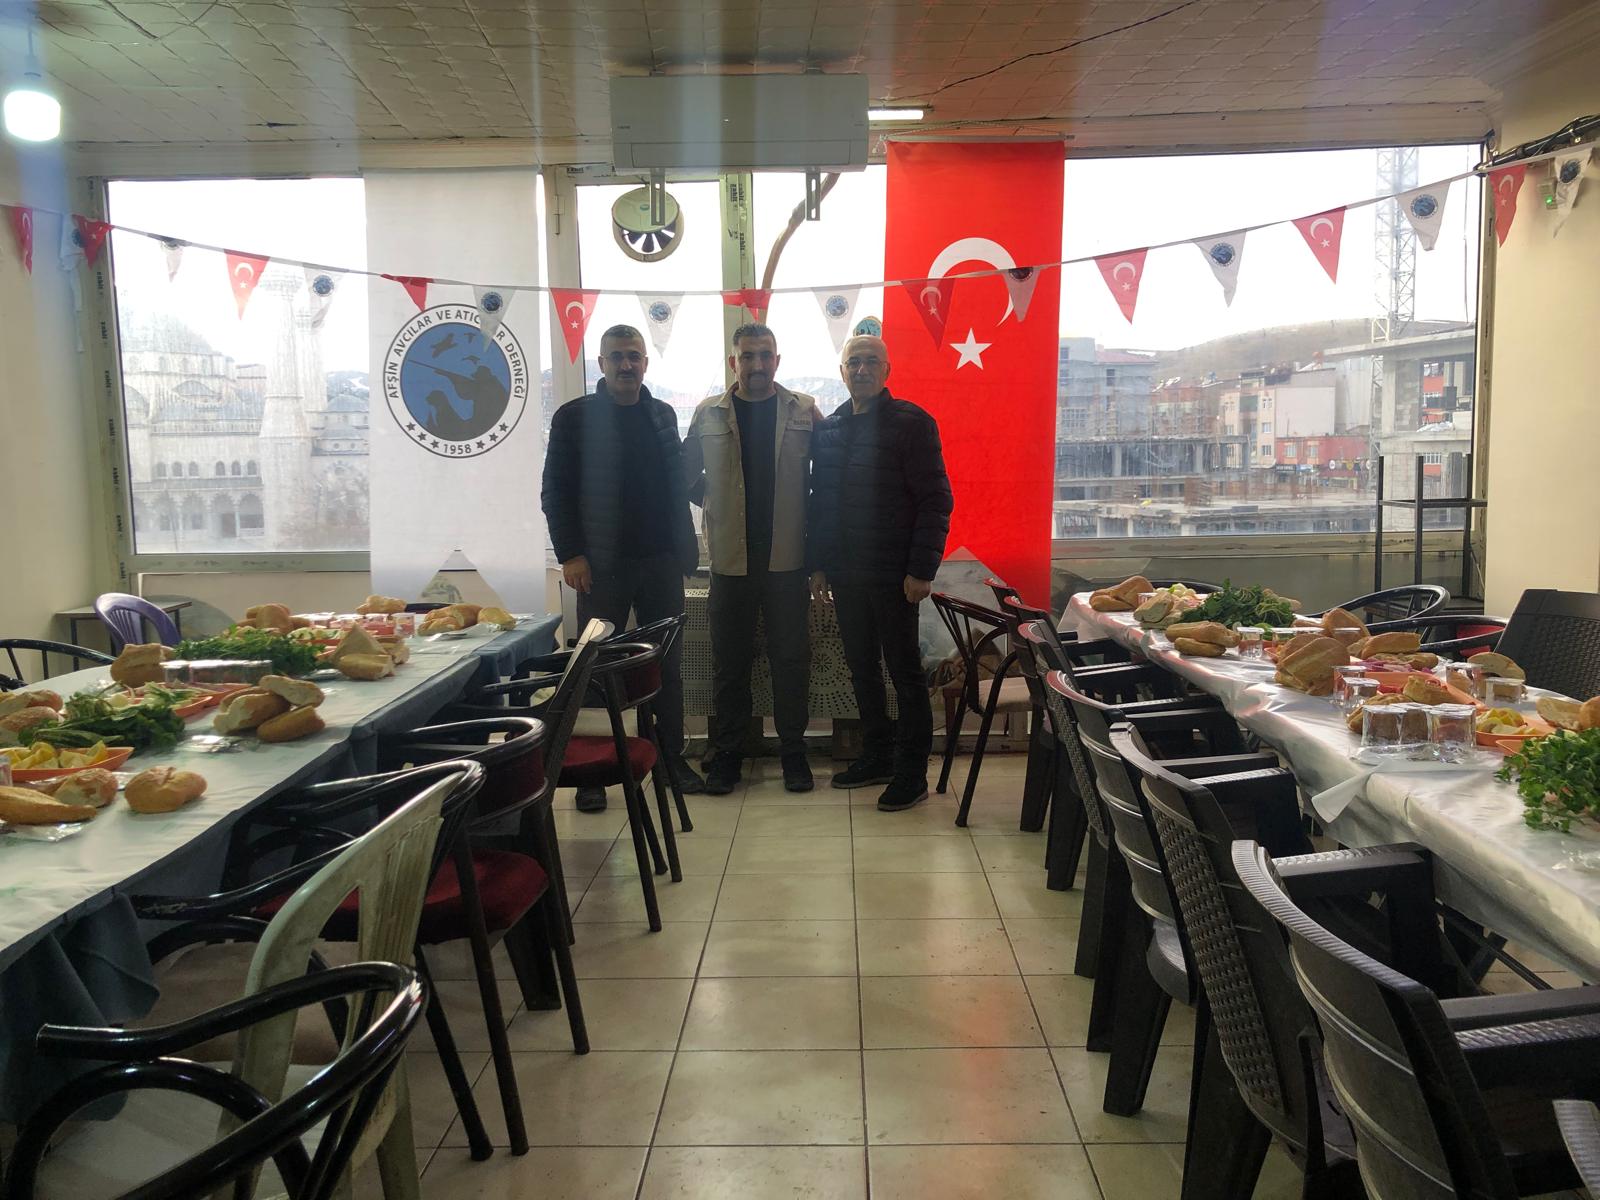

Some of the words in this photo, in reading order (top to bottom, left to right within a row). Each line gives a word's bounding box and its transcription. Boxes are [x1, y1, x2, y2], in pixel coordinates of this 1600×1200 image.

[387, 362, 400, 398] AFŞİN
[394, 315, 432, 357] AVCILAR
[436, 309, 452, 321] VE
[455, 309, 505, 341] ATICR
[505, 343, 525, 399] DERNEĞİ
[443, 444, 472, 454] 1958
